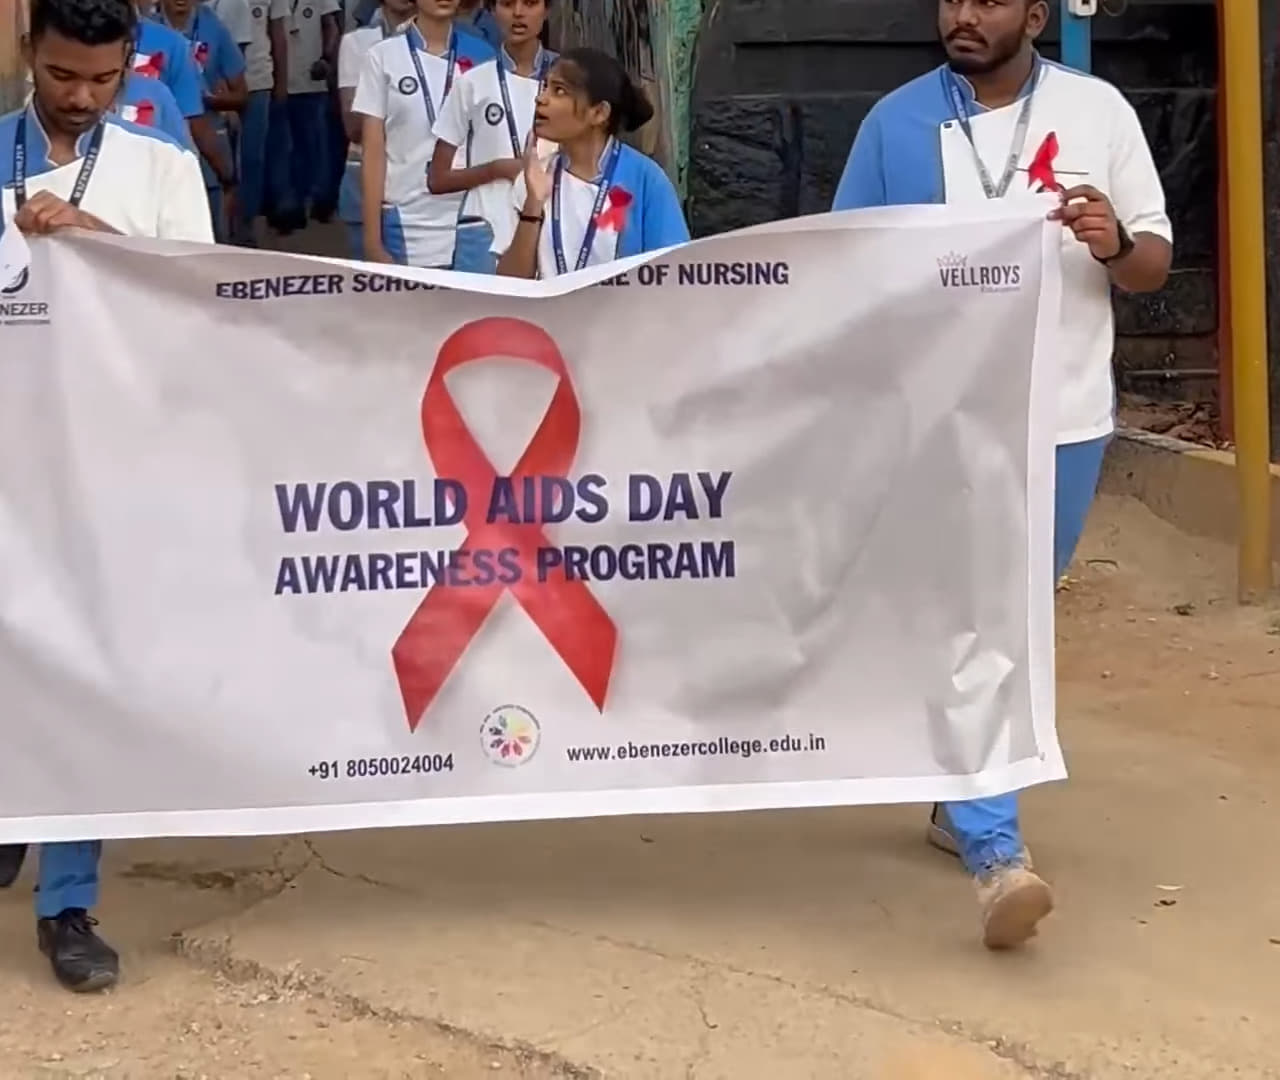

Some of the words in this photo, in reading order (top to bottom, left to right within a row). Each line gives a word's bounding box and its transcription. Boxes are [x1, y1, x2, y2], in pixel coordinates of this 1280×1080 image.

[216, 274, 343, 299] EBENEZER
[639, 264, 670, 286] OF
[679, 261, 790, 286] NURSING
[939, 264, 1021, 288] VELLROYS
[275, 478, 469, 533] WORLD
[486, 473, 609, 525] AIDS
[628, 471, 734, 522] DAY
[274, 548, 523, 596] AWARENESS
[536, 540, 737, 583] PROGRAM
[566, 732, 826, 763] www.ebenezercollege.edu.in
[308, 760, 339, 780] +91
[346, 753, 454, 778] 8050024004
